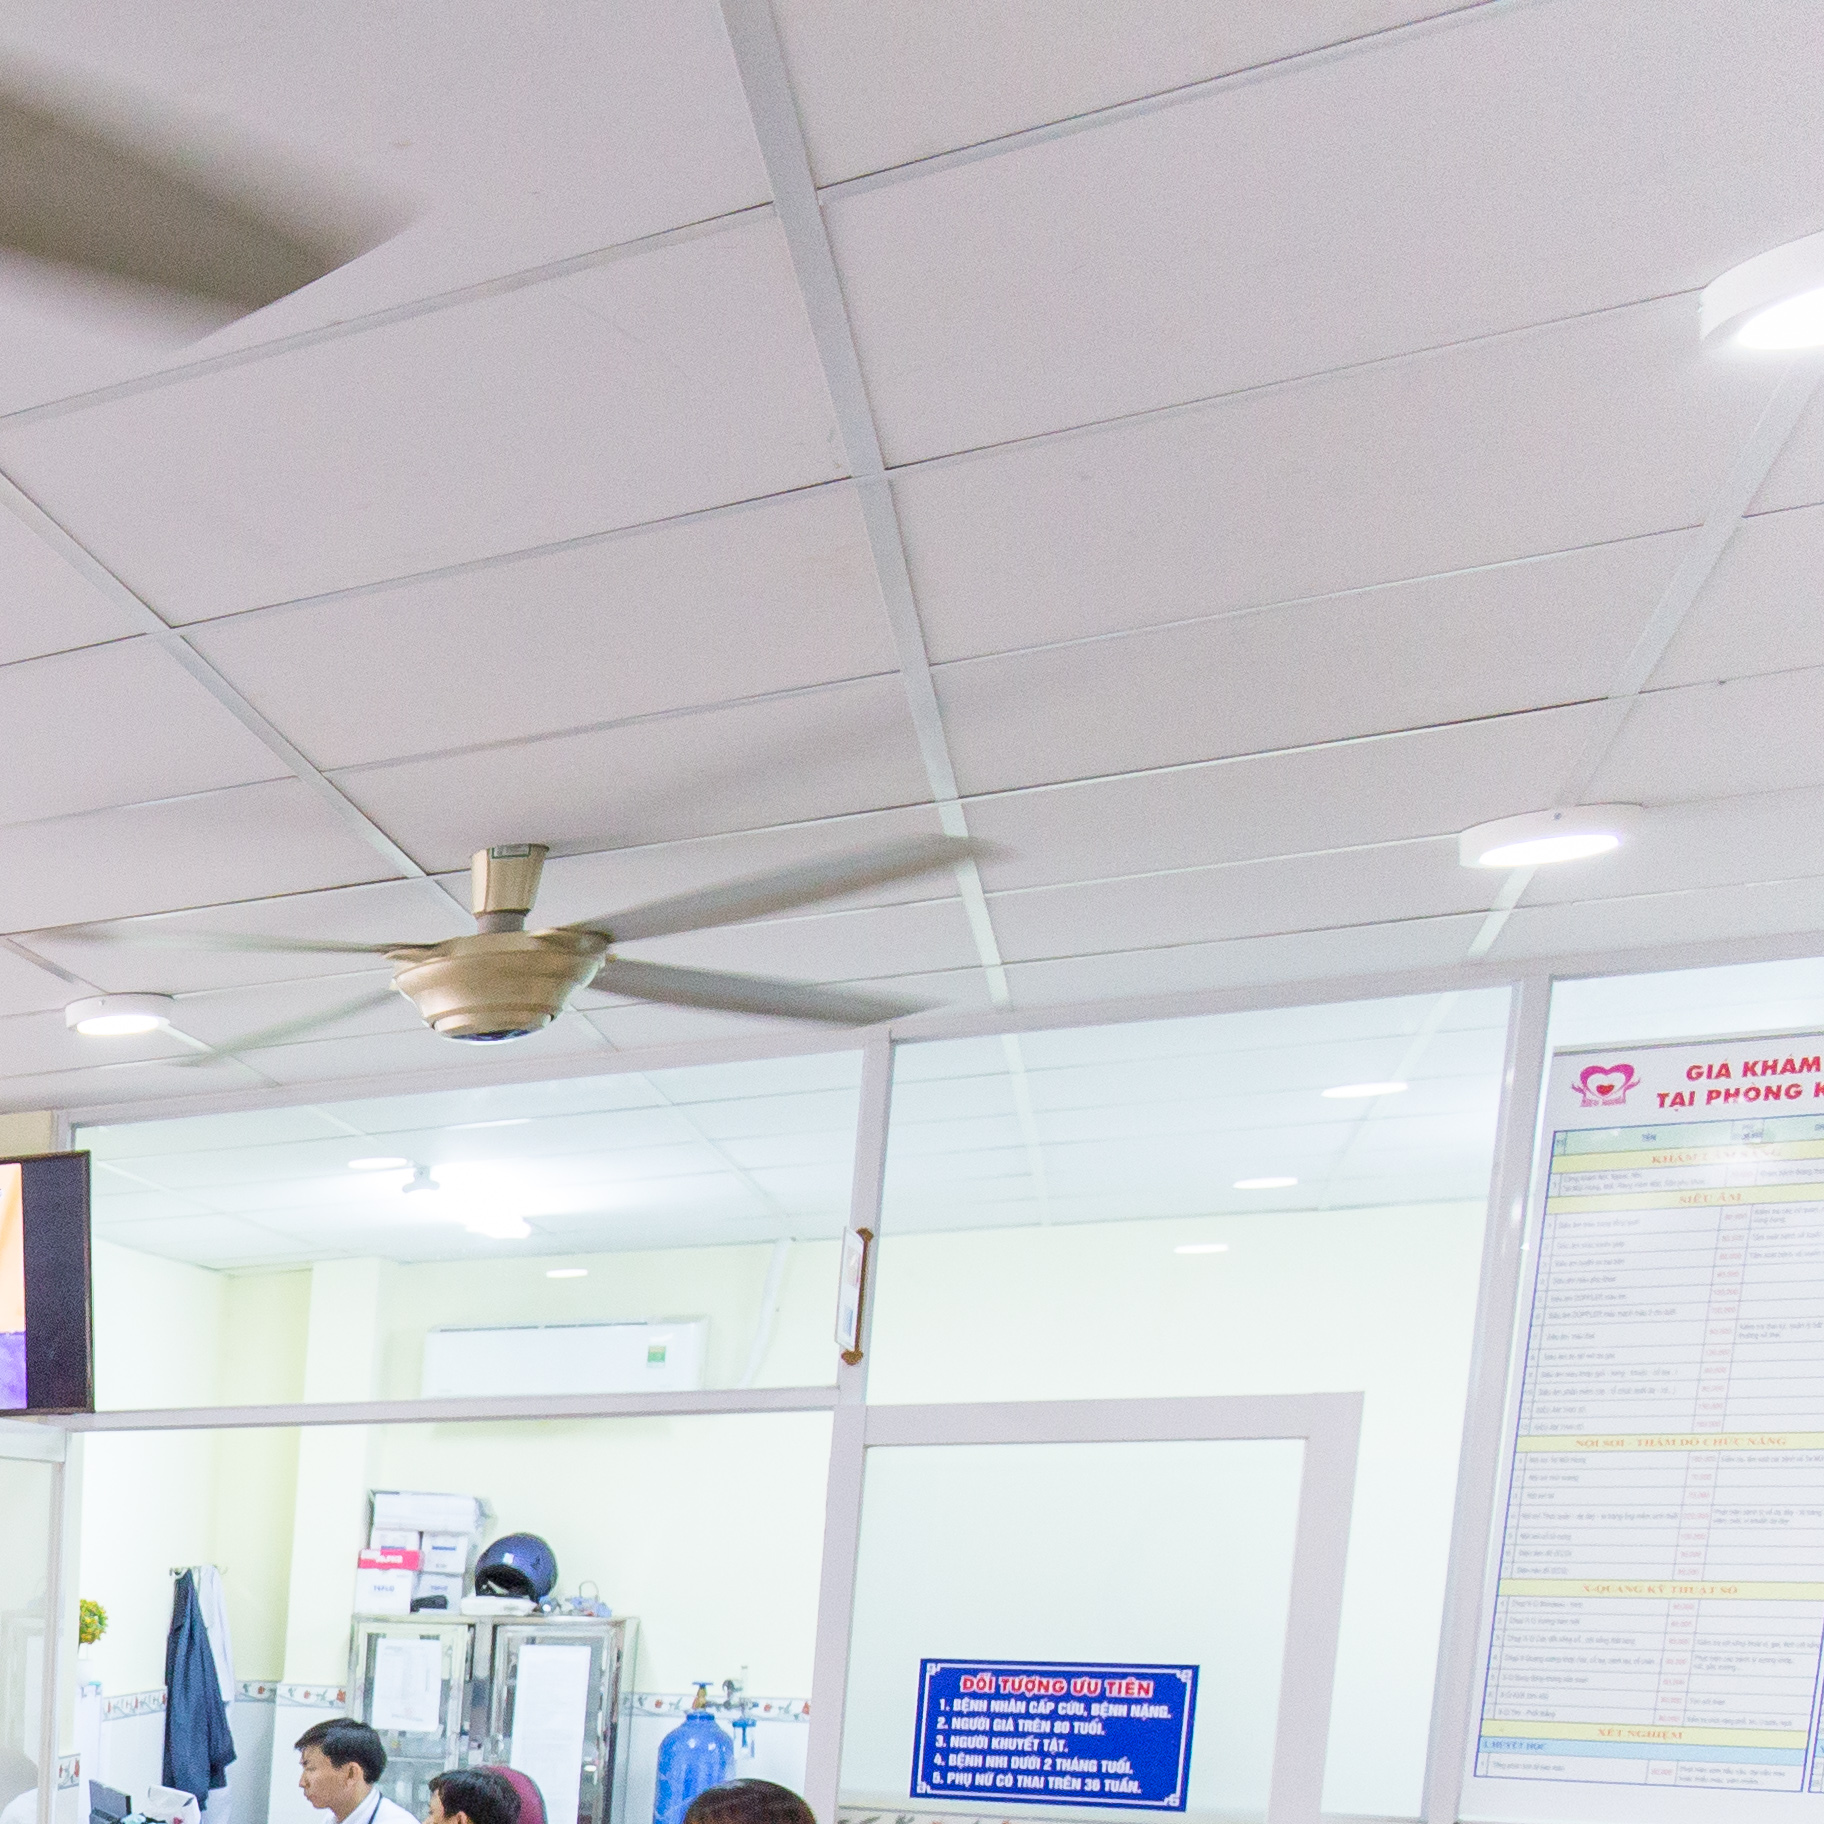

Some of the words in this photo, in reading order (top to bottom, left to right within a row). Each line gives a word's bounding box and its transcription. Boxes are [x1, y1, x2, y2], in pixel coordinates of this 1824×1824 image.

[1686, 1059, 1731, 1081] GIÁ
[1742, 1054, 1821, 1077] KHÁM
[1657, 1091, 1696, 1112] TẠI
[1706, 1083, 1802, 1106] PHÒNG
[960, 1672, 995, 1693] ĐỐI
[1000, 1676, 1066, 1698] TƯỢNG
[1071, 1679, 1100, 1696] ƯU
[1106, 1677, 1154, 1698] TIÊN
[940, 1699, 950, 1711] 1.
[953, 1698, 987, 1717] BỆNH
[990, 1697, 1025, 1714] NHÂN
[1029, 1698, 1054, 1714] CẤP
[1092, 1701, 1127, 1721] BỆNH
[937, 1717, 948, 1729] 2.
[1018, 1717, 1050, 1733] TRÊN
[936, 1735, 947, 1748] 3.
[991, 1734, 1040, 1752] KHUYẾT
[934, 1753, 946, 1766] 4.
[948, 1752, 983, 1771] BỆNH
[986, 1755, 1008, 1769] NHI
[1044, 1758, 1052, 1771] 2
[1056, 1752, 1097, 1772] THÁNG
[933, 1772, 944, 1784] 5.
[947, 1772, 972, 1789] PHỤ
[996, 1773, 1014, 1788] CÓ
[1017, 1776, 1043, 1789] THAI
[1048, 1773, 1081, 1791] TRÊN
